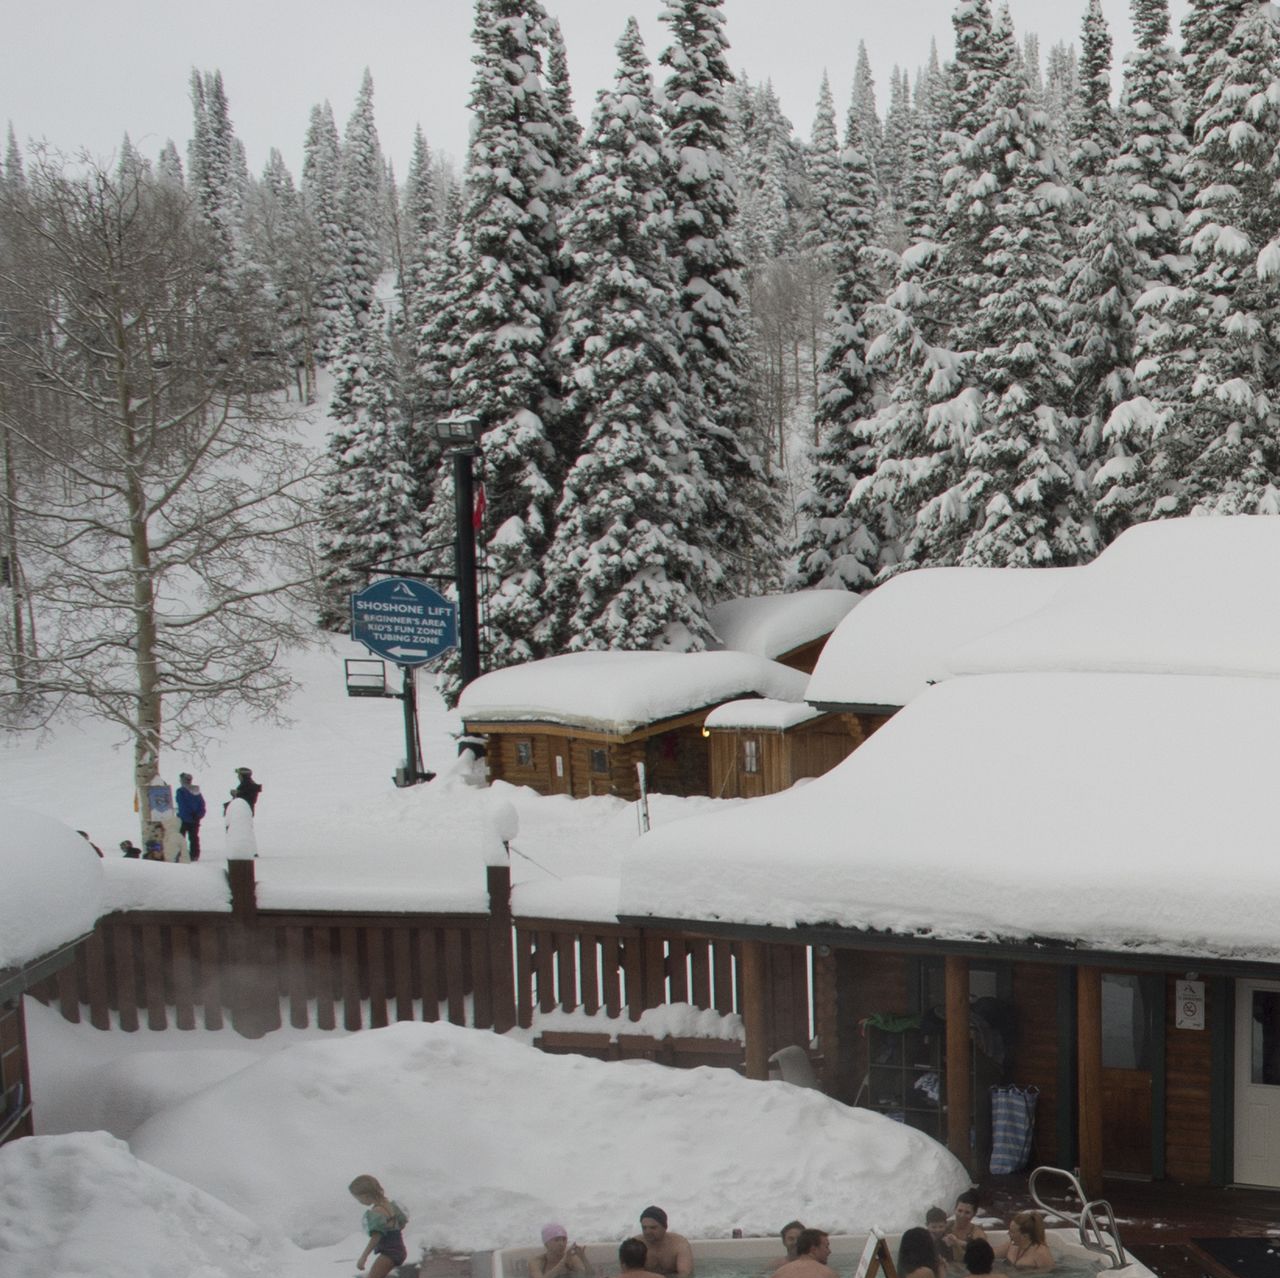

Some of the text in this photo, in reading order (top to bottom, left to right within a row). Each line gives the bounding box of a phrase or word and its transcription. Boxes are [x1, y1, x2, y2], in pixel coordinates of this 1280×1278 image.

[356, 601, 453, 616] SHOSHONE LIFT
[363, 614, 447, 627] BEGINNER'S AREA
[368, 624, 444, 636] KID'S FUN ZONE
[373, 632, 440, 645] TUBING ZONE
